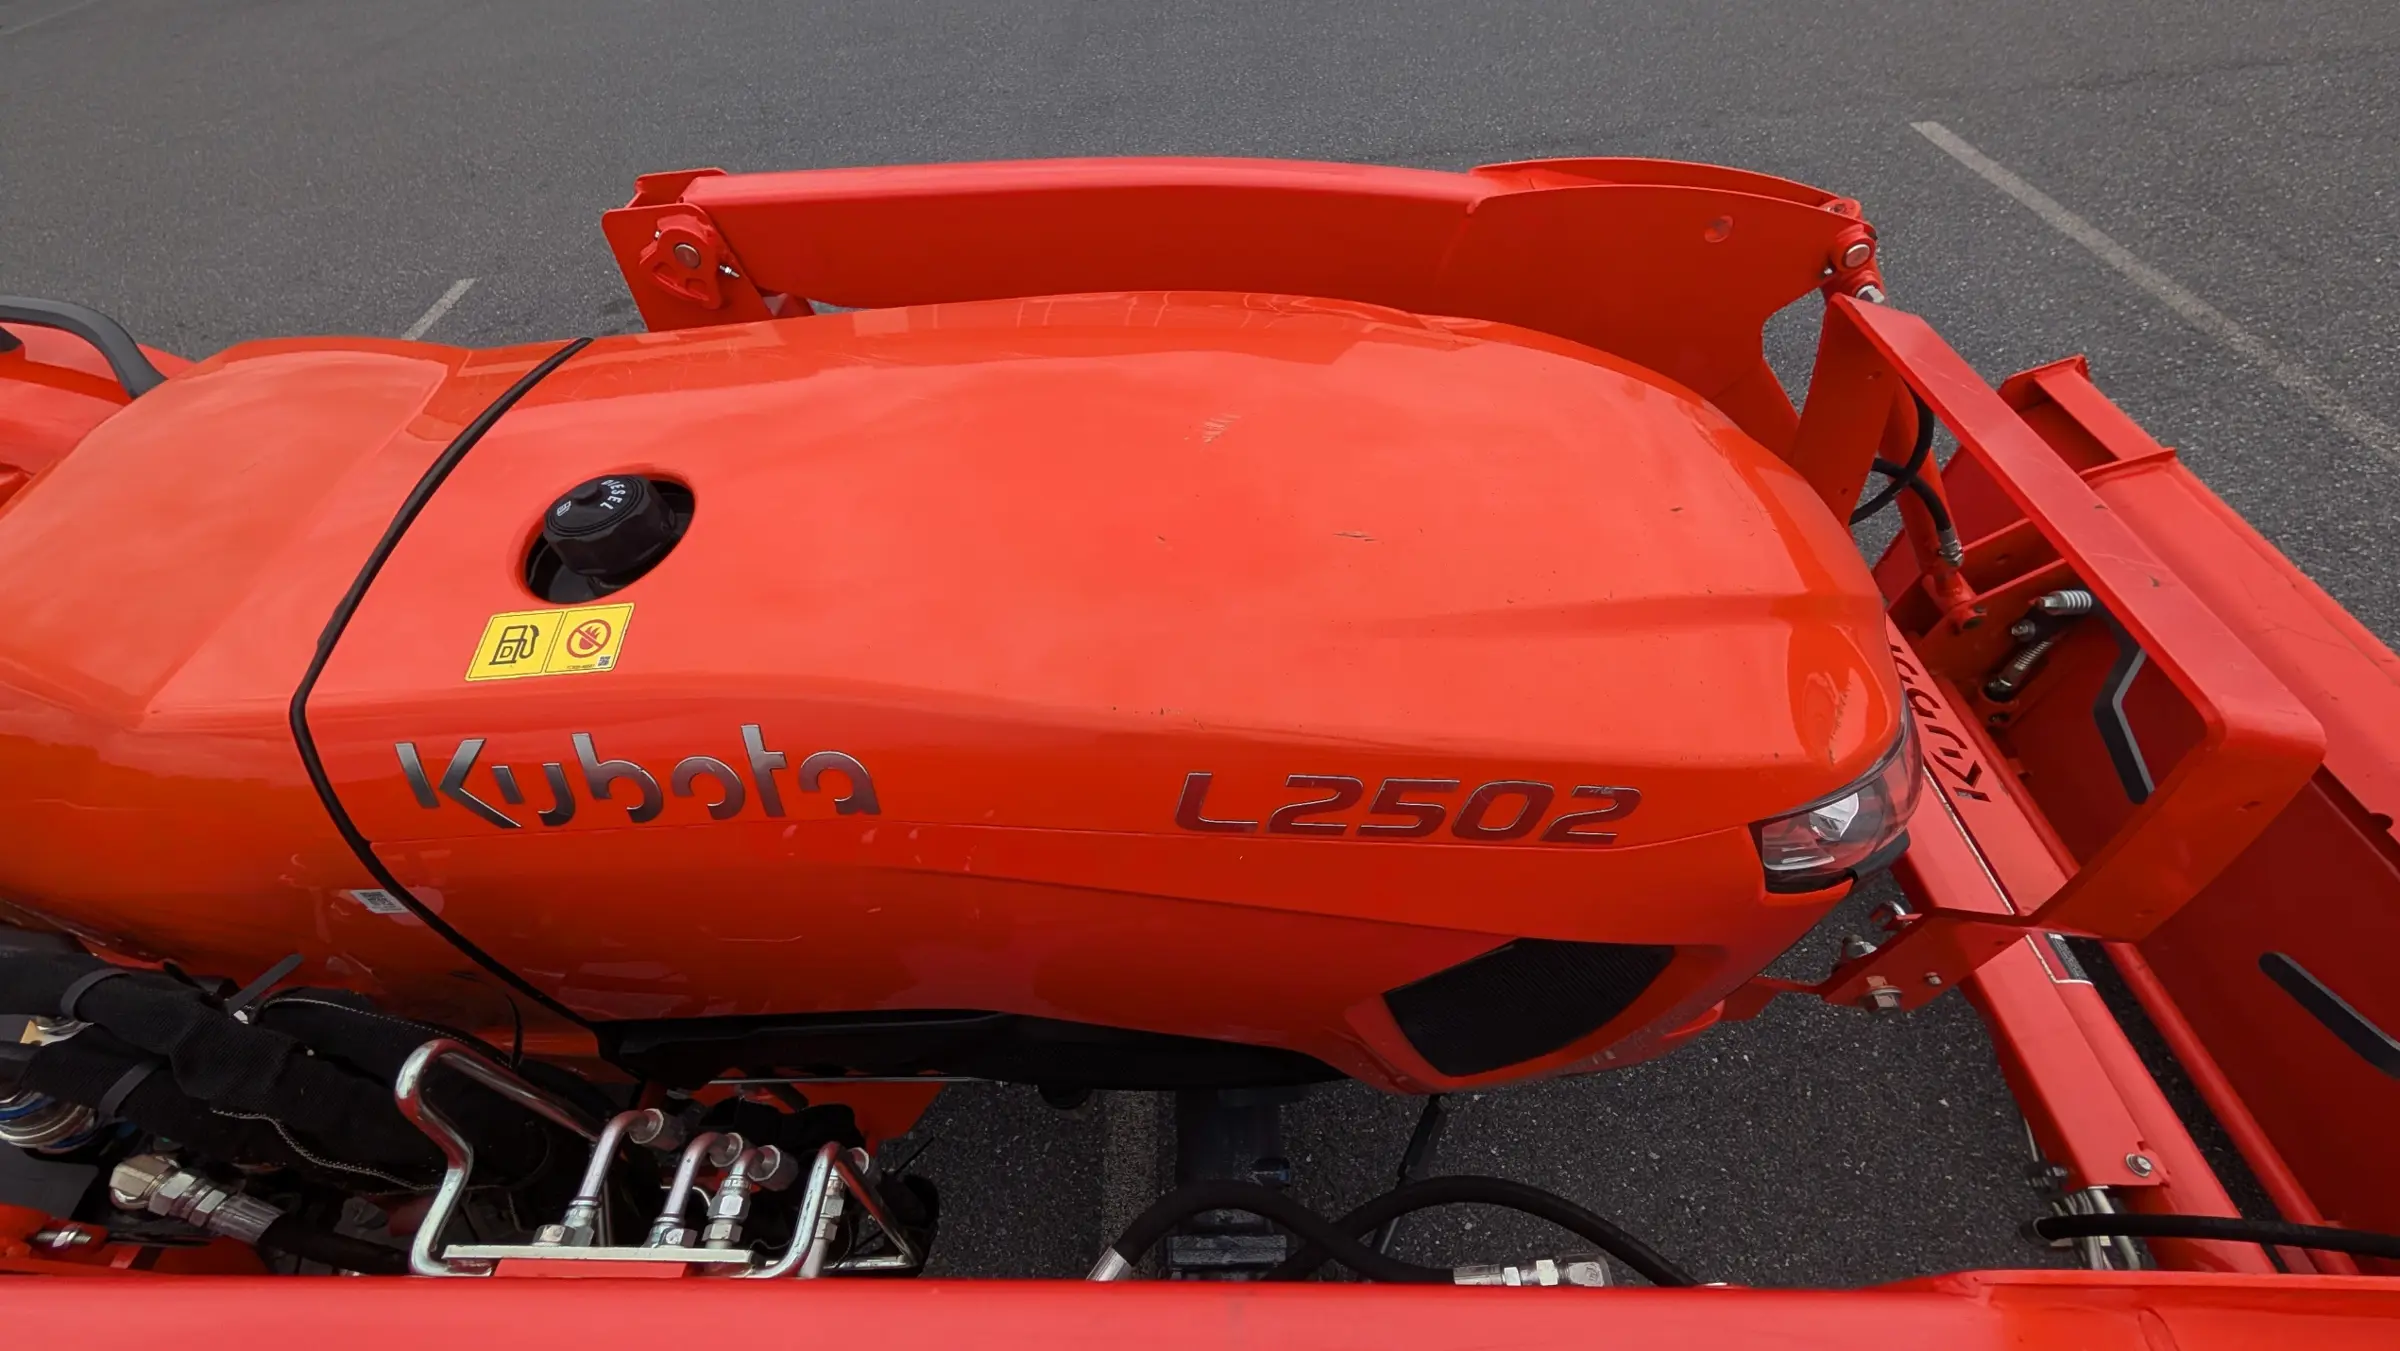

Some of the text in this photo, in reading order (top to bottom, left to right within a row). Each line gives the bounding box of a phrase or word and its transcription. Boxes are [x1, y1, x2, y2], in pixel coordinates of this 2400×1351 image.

[600, 479, 626, 510] DIESEL
[394, 723, 882, 829] Kubota
[1174, 770, 1643, 845] L2502
